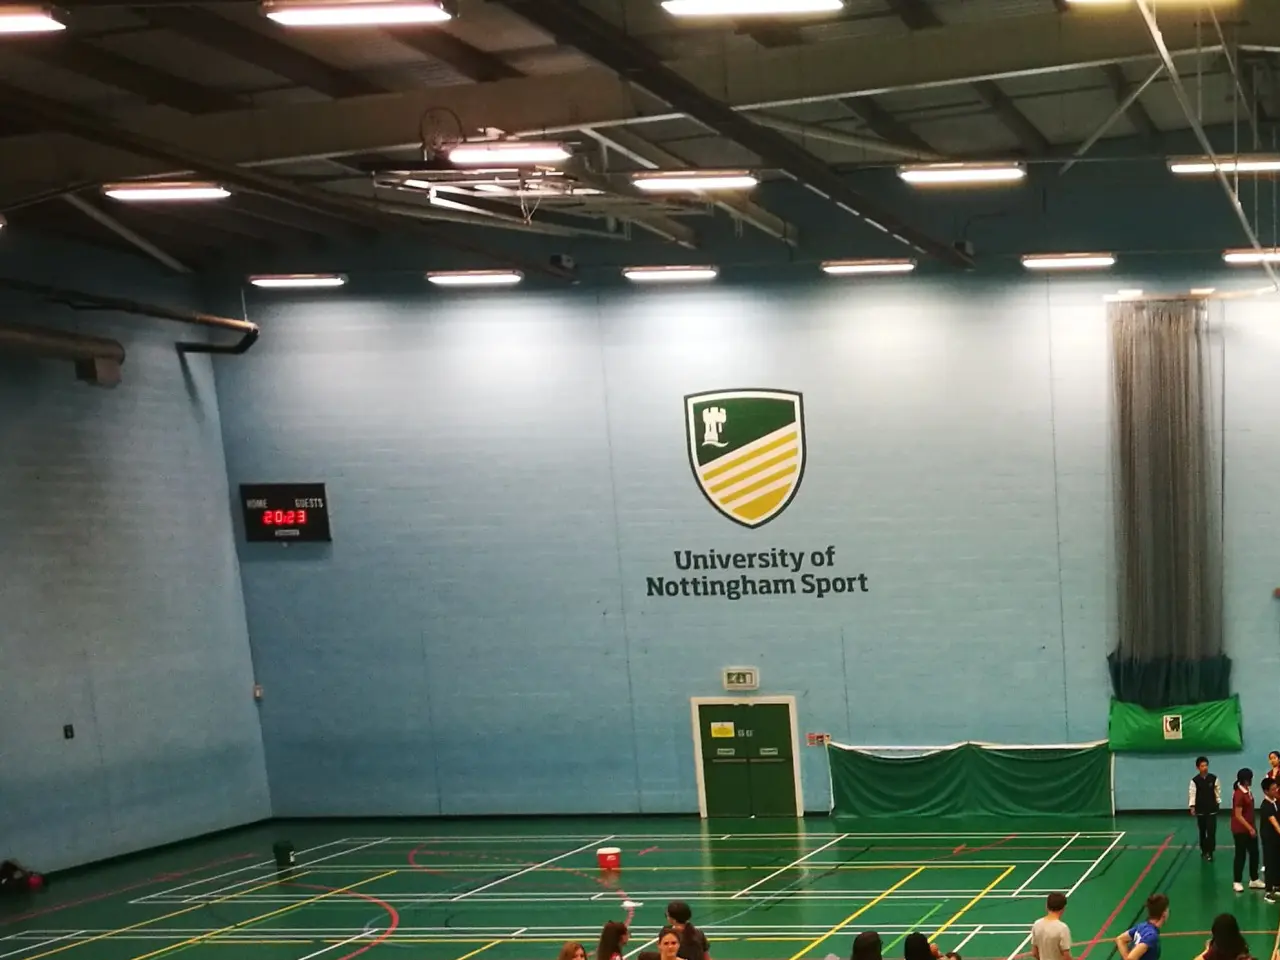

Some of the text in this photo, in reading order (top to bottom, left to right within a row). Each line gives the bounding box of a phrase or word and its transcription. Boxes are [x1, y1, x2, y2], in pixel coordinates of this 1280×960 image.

[246, 498, 323, 509] HOME GUESTS
[674, 545, 836, 572] University of
[646, 573, 869, 600] Nottingham Sport
